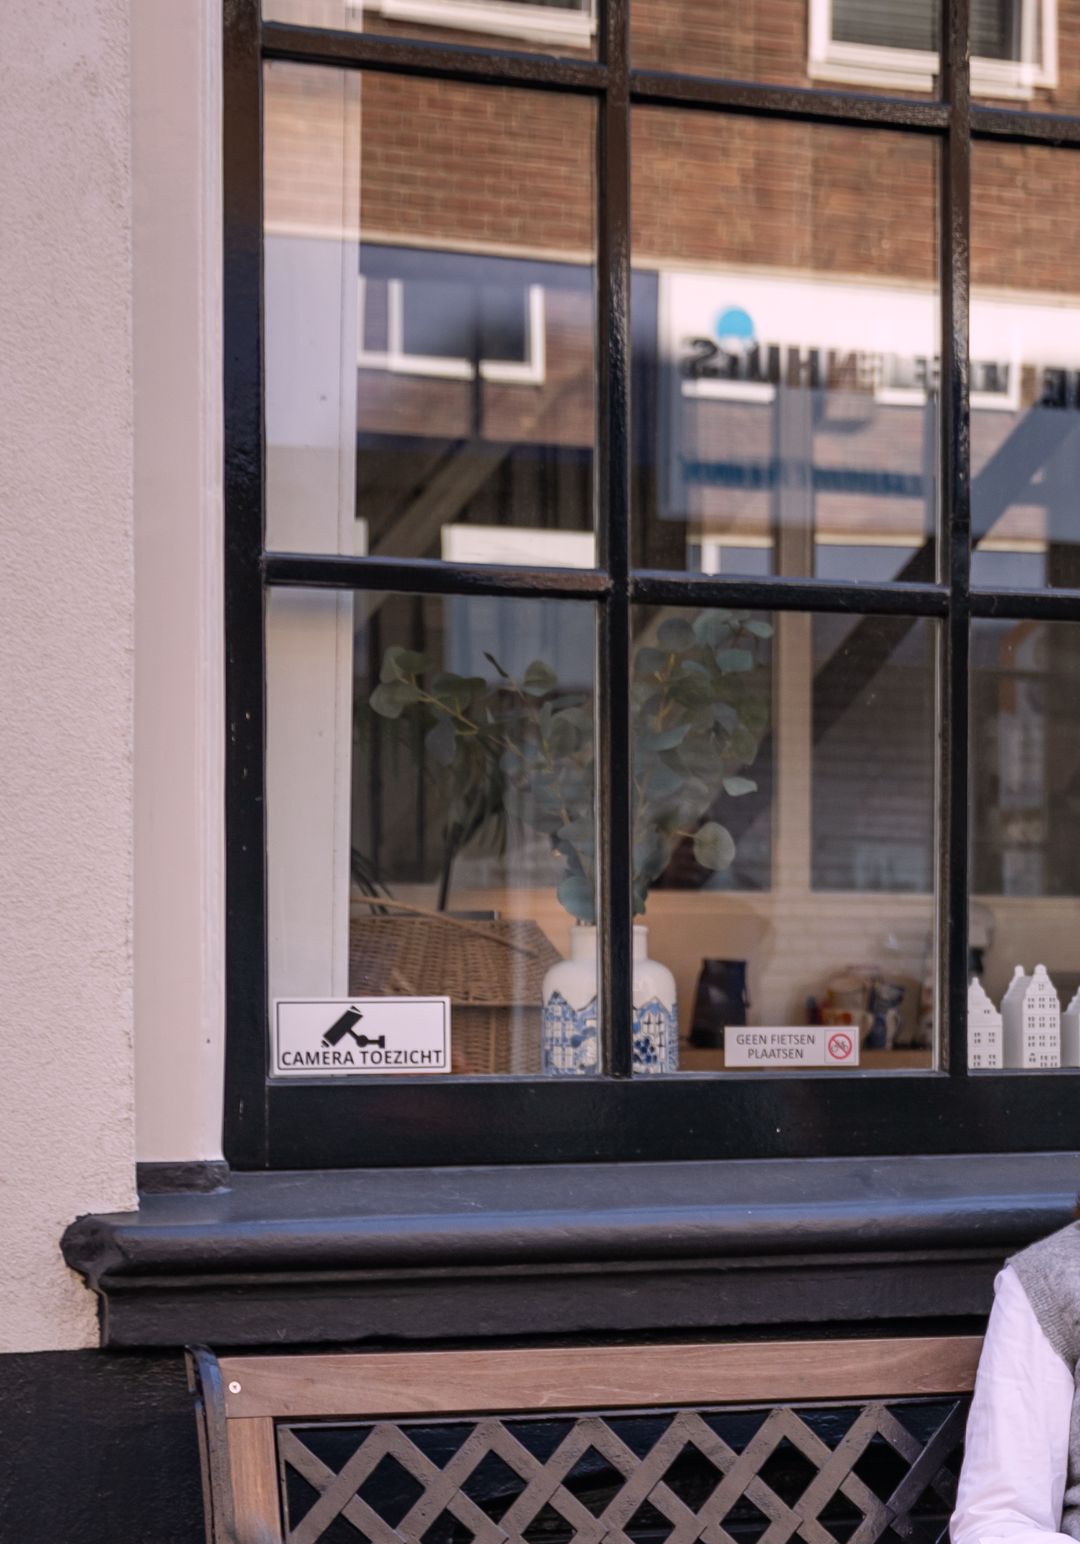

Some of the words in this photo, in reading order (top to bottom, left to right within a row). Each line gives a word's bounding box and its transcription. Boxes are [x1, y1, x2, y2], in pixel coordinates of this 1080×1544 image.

[736, 1034, 767, 1045] GEEN
[770, 1034, 815, 1045] FIETSEN
[281, 1051, 355, 1067] CAMERA
[359, 1050, 443, 1065] TOEZICHT
[747, 1048, 804, 1059] PLAATSEN
